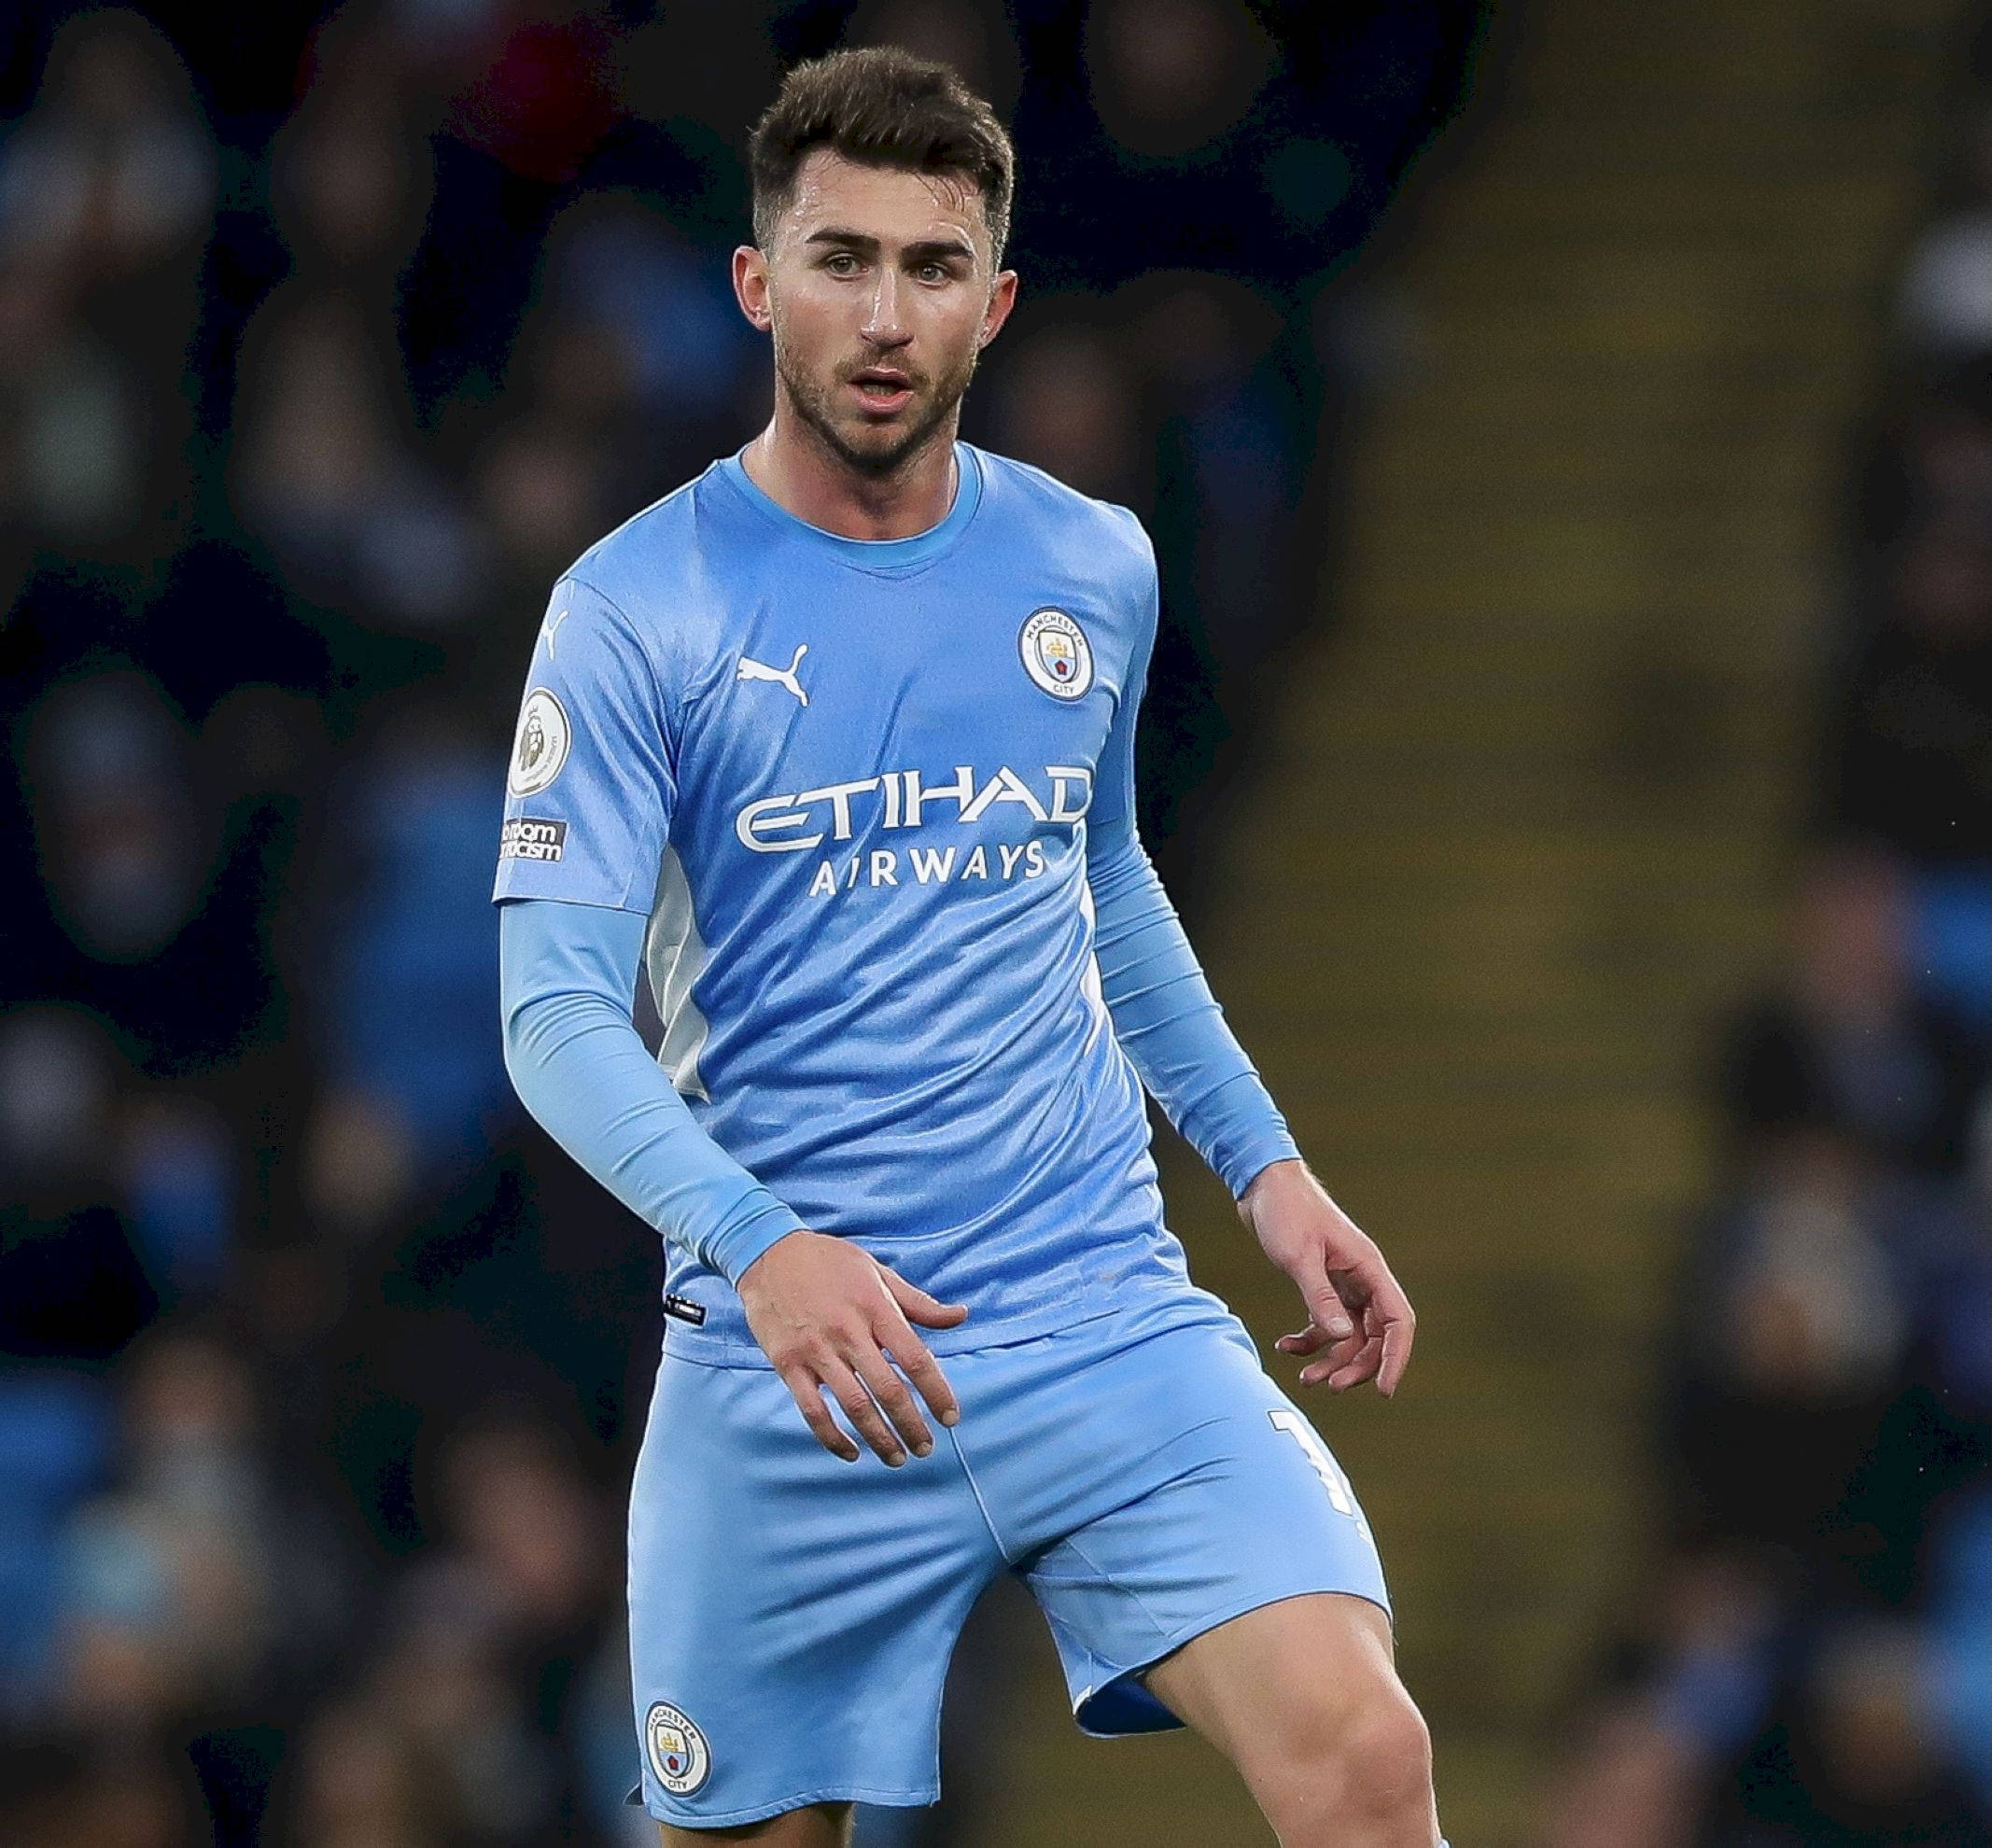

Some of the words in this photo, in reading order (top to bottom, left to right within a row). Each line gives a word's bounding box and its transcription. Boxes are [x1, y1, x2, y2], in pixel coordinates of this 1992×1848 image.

[1026, 614, 1084, 647] MANCHESTER
[1053, 684, 1074, 694] CITY
[735, 765, 1094, 853] ETIHAD
[808, 840, 1045, 897] AIRWAYS
[1268, 1410, 1372, 1546] 1
[667, 1778, 688, 1790] CITY
